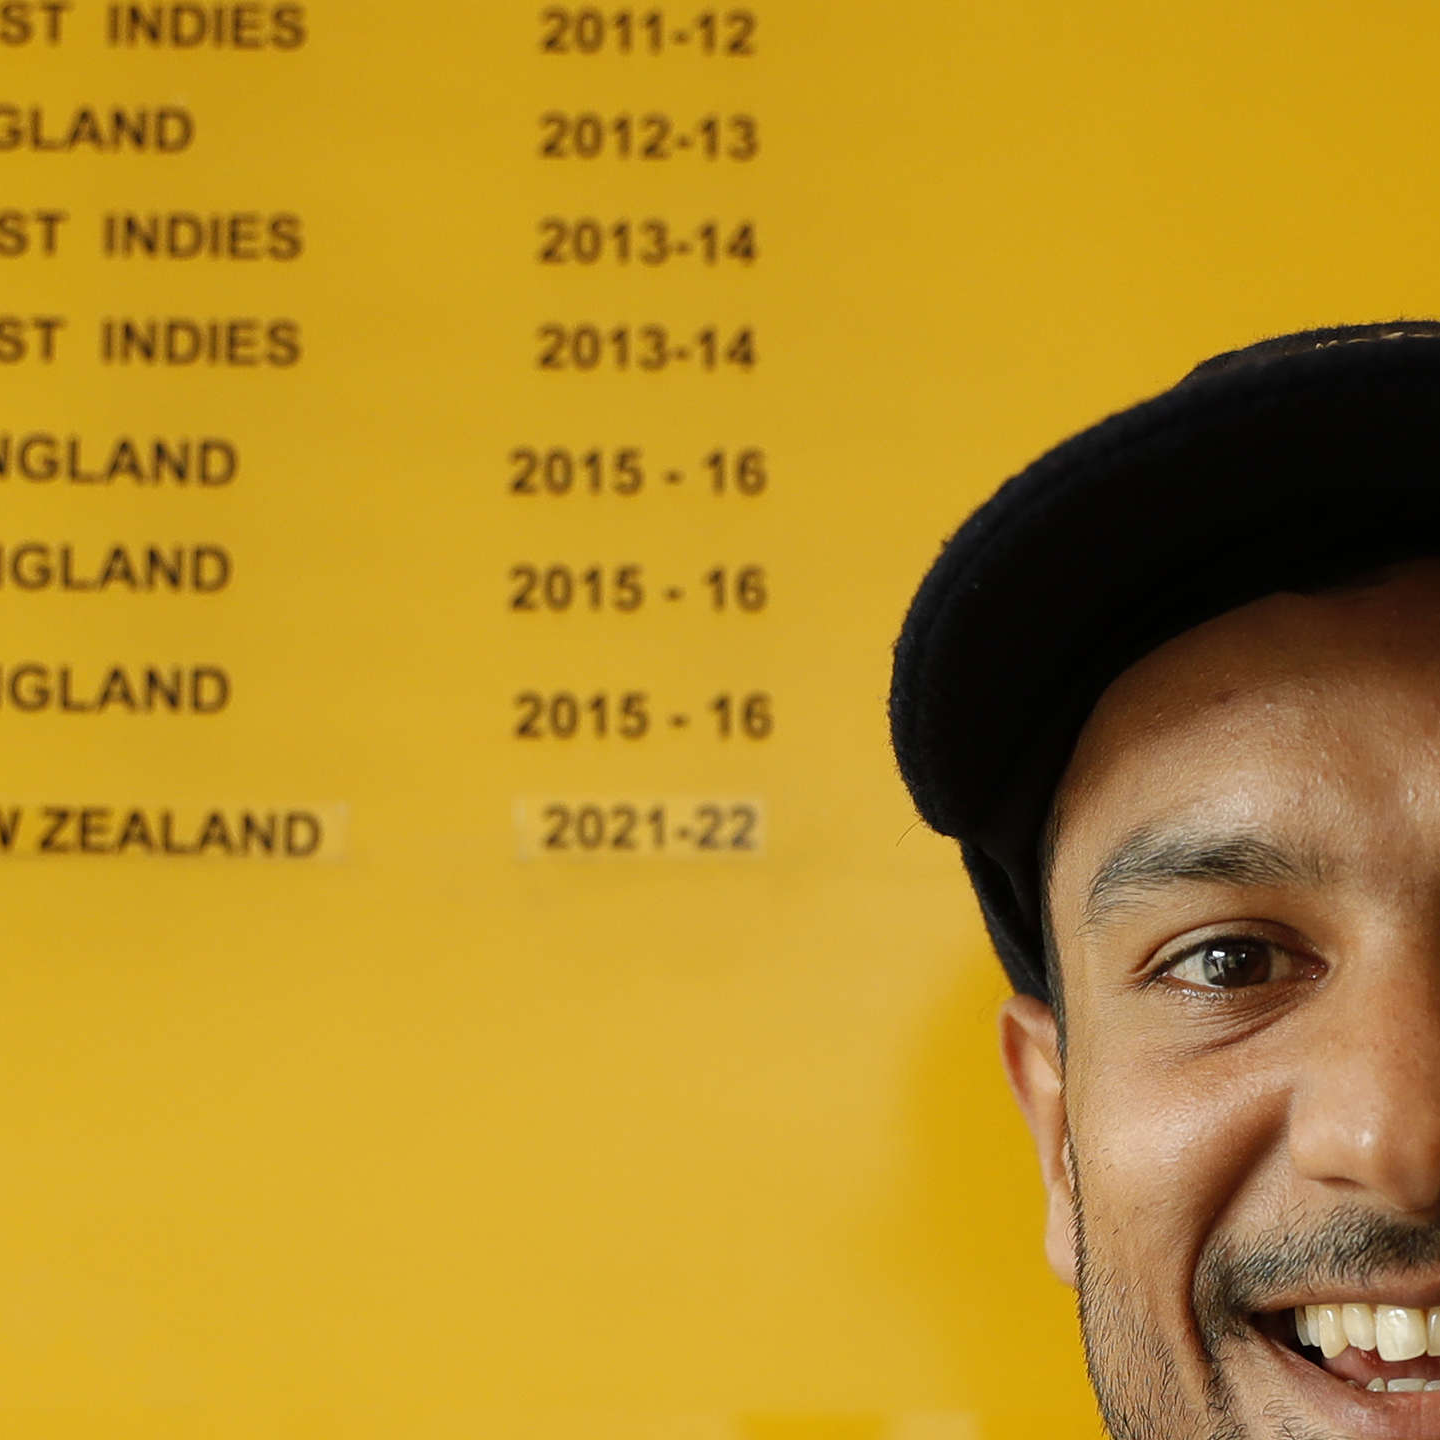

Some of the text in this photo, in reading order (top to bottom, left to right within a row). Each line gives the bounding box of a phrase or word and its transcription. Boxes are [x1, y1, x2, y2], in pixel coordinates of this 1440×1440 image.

[107, 0, 307, 51] INDIES
[540, 6, 758, 58] 2011-12
[539, 112, 760, 163] 2012-13
[103, 212, 305, 262] INDIES
[537, 216, 759, 266] 2013-14
[101, 318, 302, 369] INDIES
[536, 322, 757, 372] 2013-14
[507, 446, 644, 497] 2015
[705, 447, 768, 498] 16
[507, 563, 645, 613] 2015
[704, 564, 768, 614] 16
[513, 690, 650, 741] 2015
[710, 692, 773, 742] 16
[37, 806, 323, 861] ZEALAND
[542, 803, 757, 852] 2021-22
